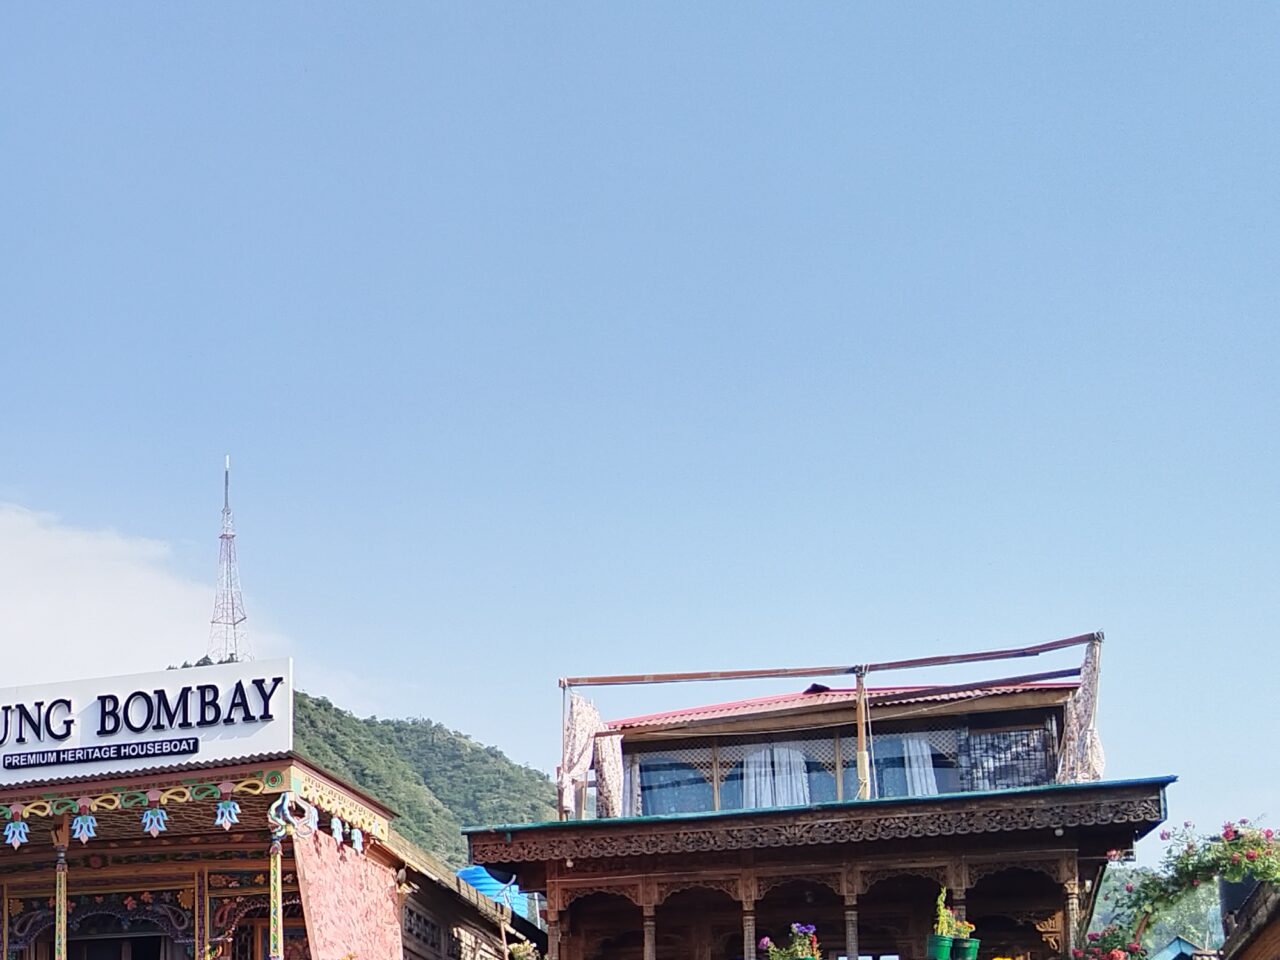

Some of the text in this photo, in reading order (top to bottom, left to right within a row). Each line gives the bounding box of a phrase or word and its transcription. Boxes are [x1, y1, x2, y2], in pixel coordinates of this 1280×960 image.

[97, 677, 283, 736] BOMBAY
[4, 739, 196, 768] PREMIUM HERITAGE HOUSEBOAT
